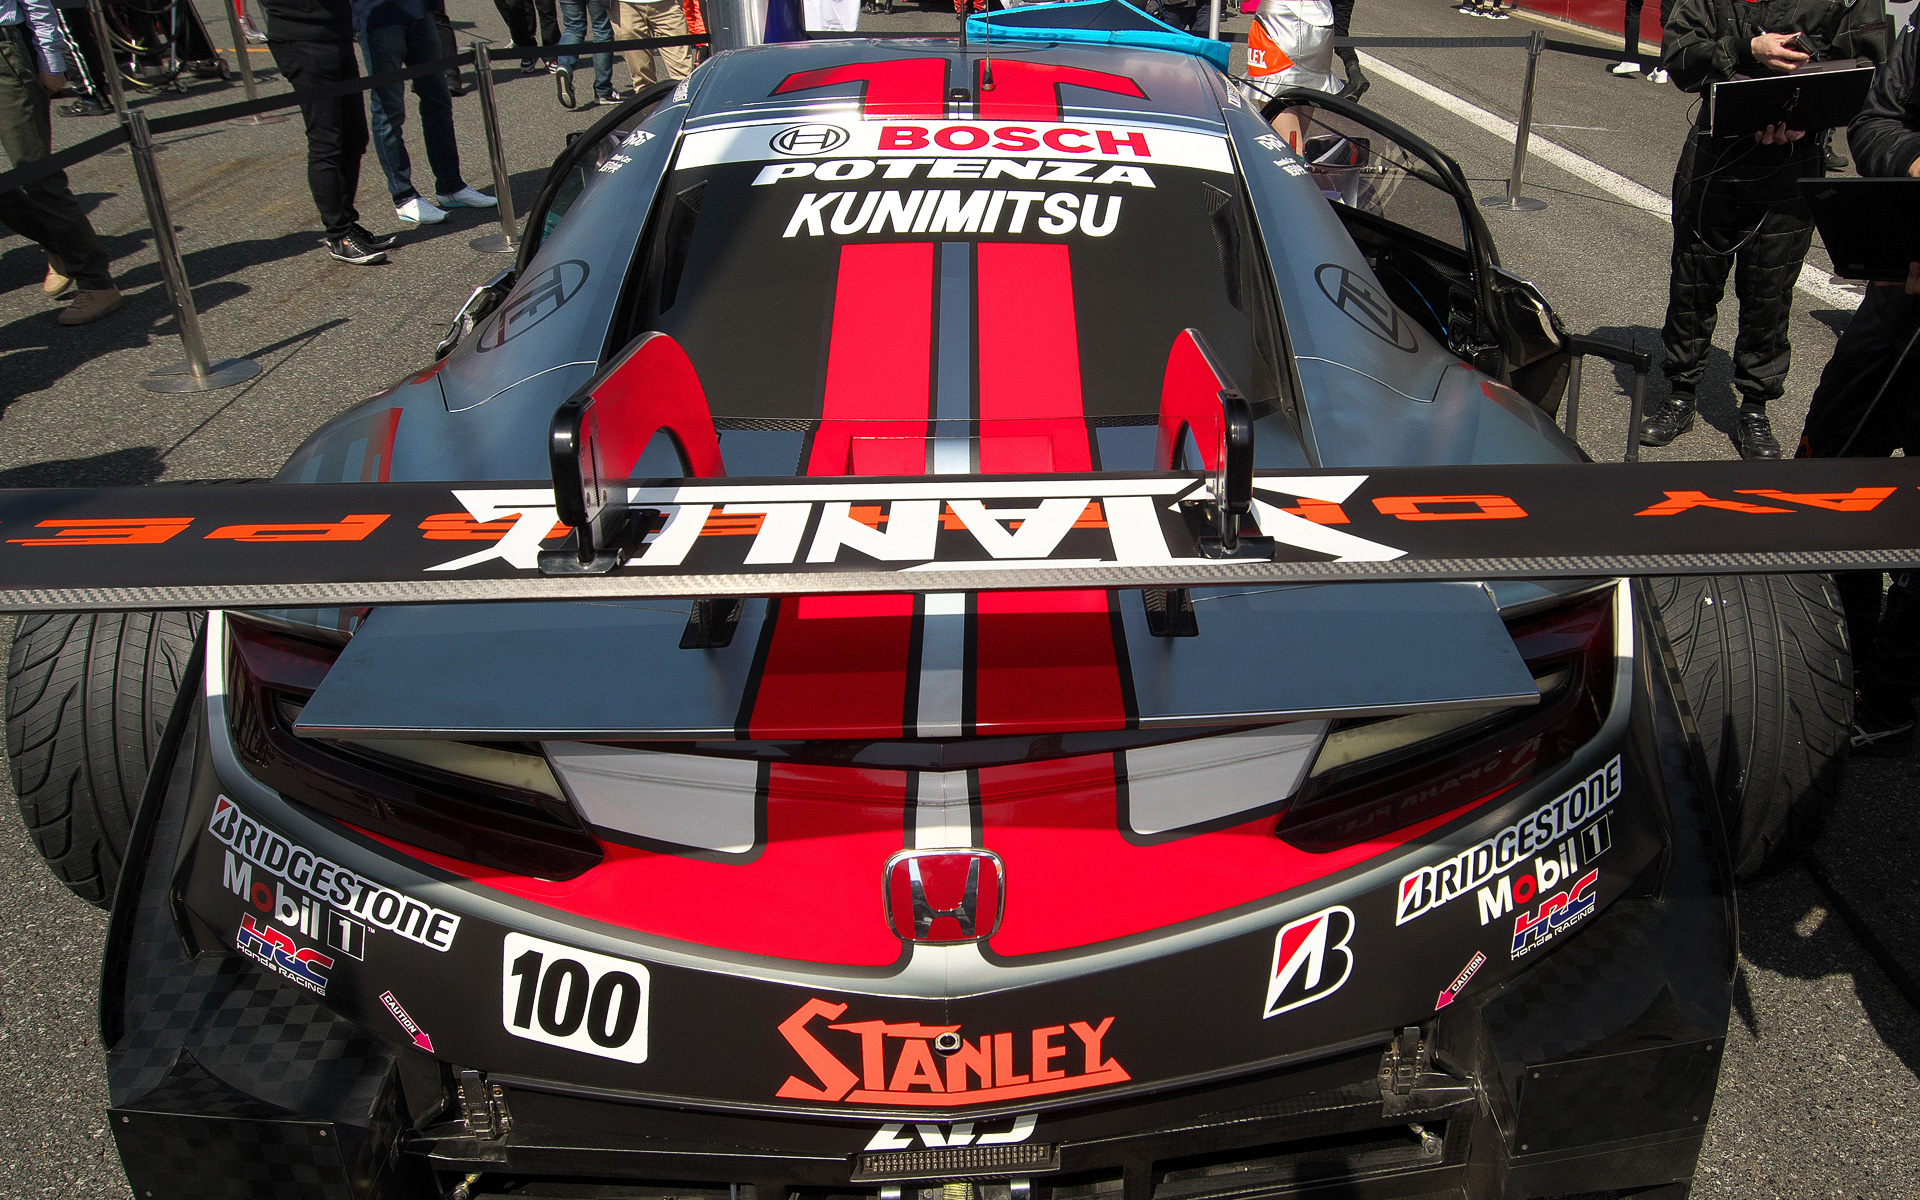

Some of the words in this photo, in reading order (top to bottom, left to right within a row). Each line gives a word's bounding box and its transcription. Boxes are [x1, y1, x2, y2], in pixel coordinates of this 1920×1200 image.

[751, 158, 1156, 188] POTENZA
[876, 125, 1151, 157] BOSCH
[782, 190, 1121, 238] KUNIMITSU
[425, 475, 1408, 573] STANLEY
[208, 794, 462, 953] BRIDGESTONE
[1396, 753, 1622, 926] BRIDGESTONE
[223, 850, 321, 941] Mobil
[1477, 837, 1578, 926] Mobil
[1511, 868, 1599, 953] HRC
[236, 912, 335, 988] HRC
[236, 942, 277, 971] Honda
[278, 967, 326, 996] RACING
[1511, 932, 1553, 960] Honda
[1554, 905, 1595, 936] RACING
[510, 948, 642, 1049] 100
[1450, 954, 1483, 993] CAUTION
[383, 993, 419, 1036] CAUTION
[775, 998, 1132, 1107] STANLEY
